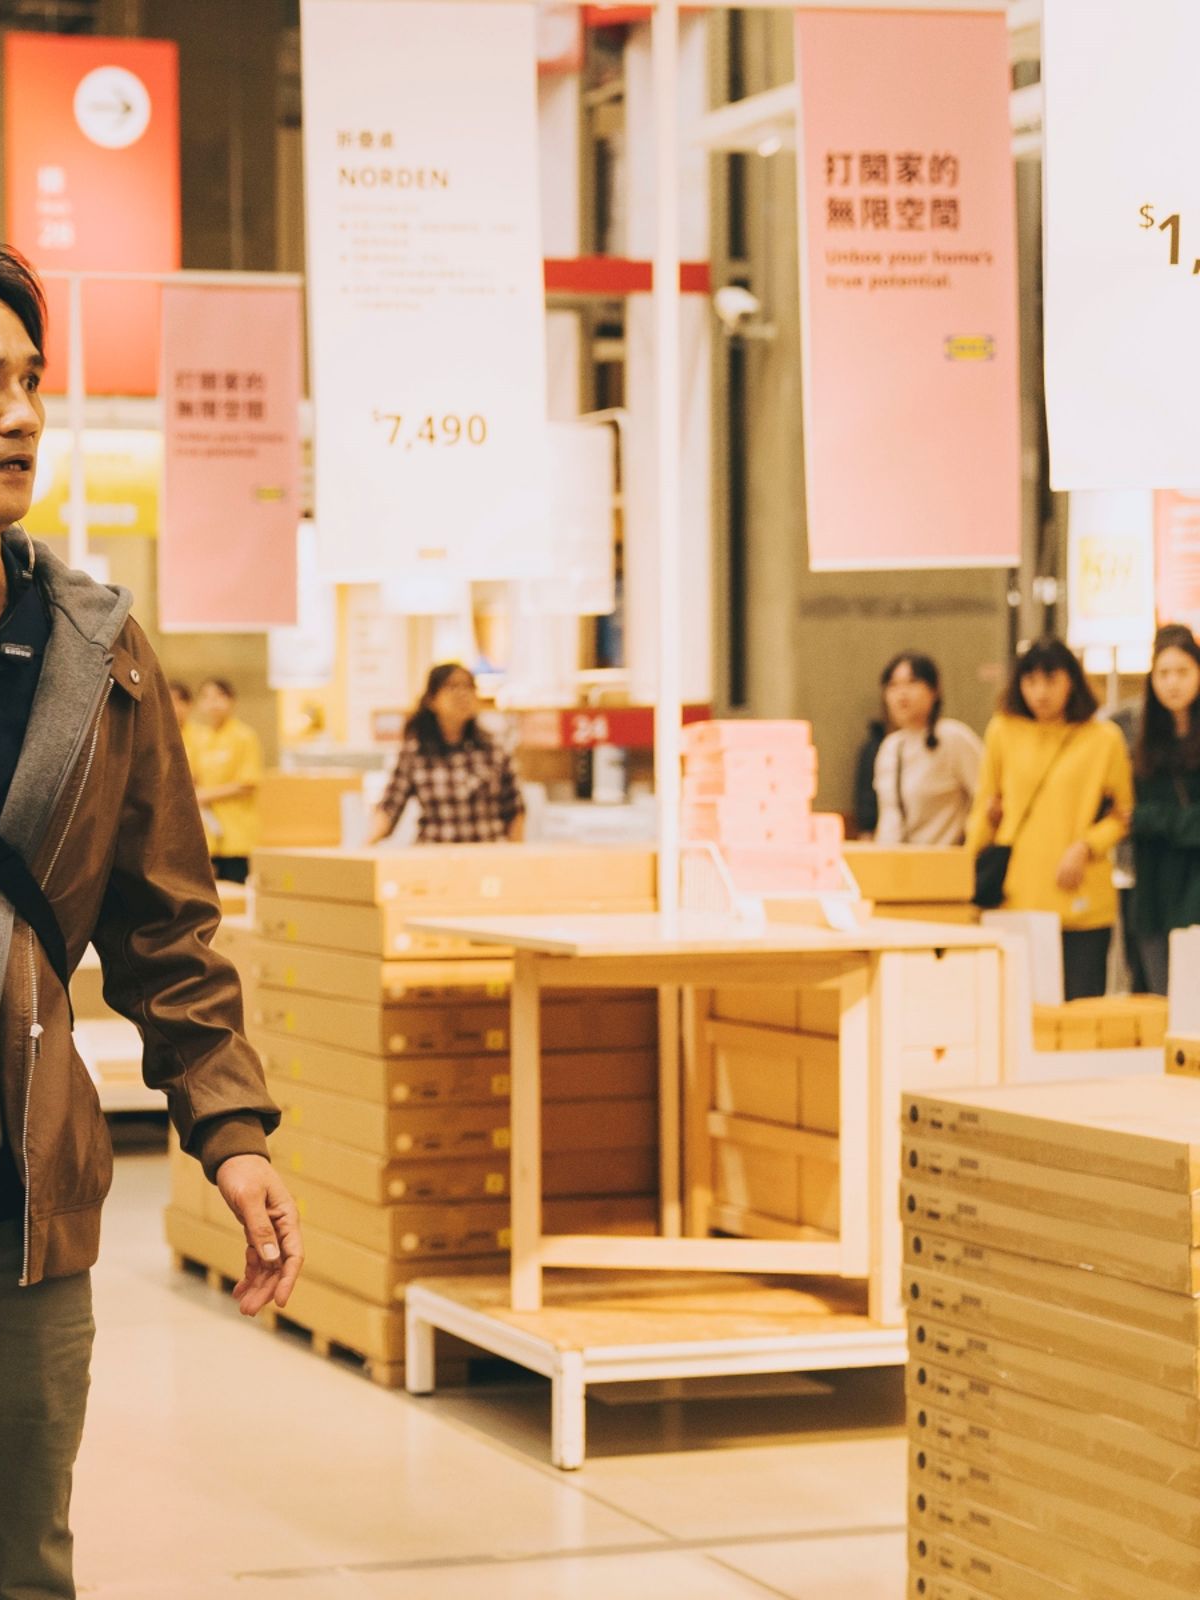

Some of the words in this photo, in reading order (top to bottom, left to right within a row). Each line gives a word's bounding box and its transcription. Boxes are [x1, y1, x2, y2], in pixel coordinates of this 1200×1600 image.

[338, 168, 449, 189] NORDEN
[826, 153, 959, 187] 打開家的
[827, 198, 960, 231] 無限空間
